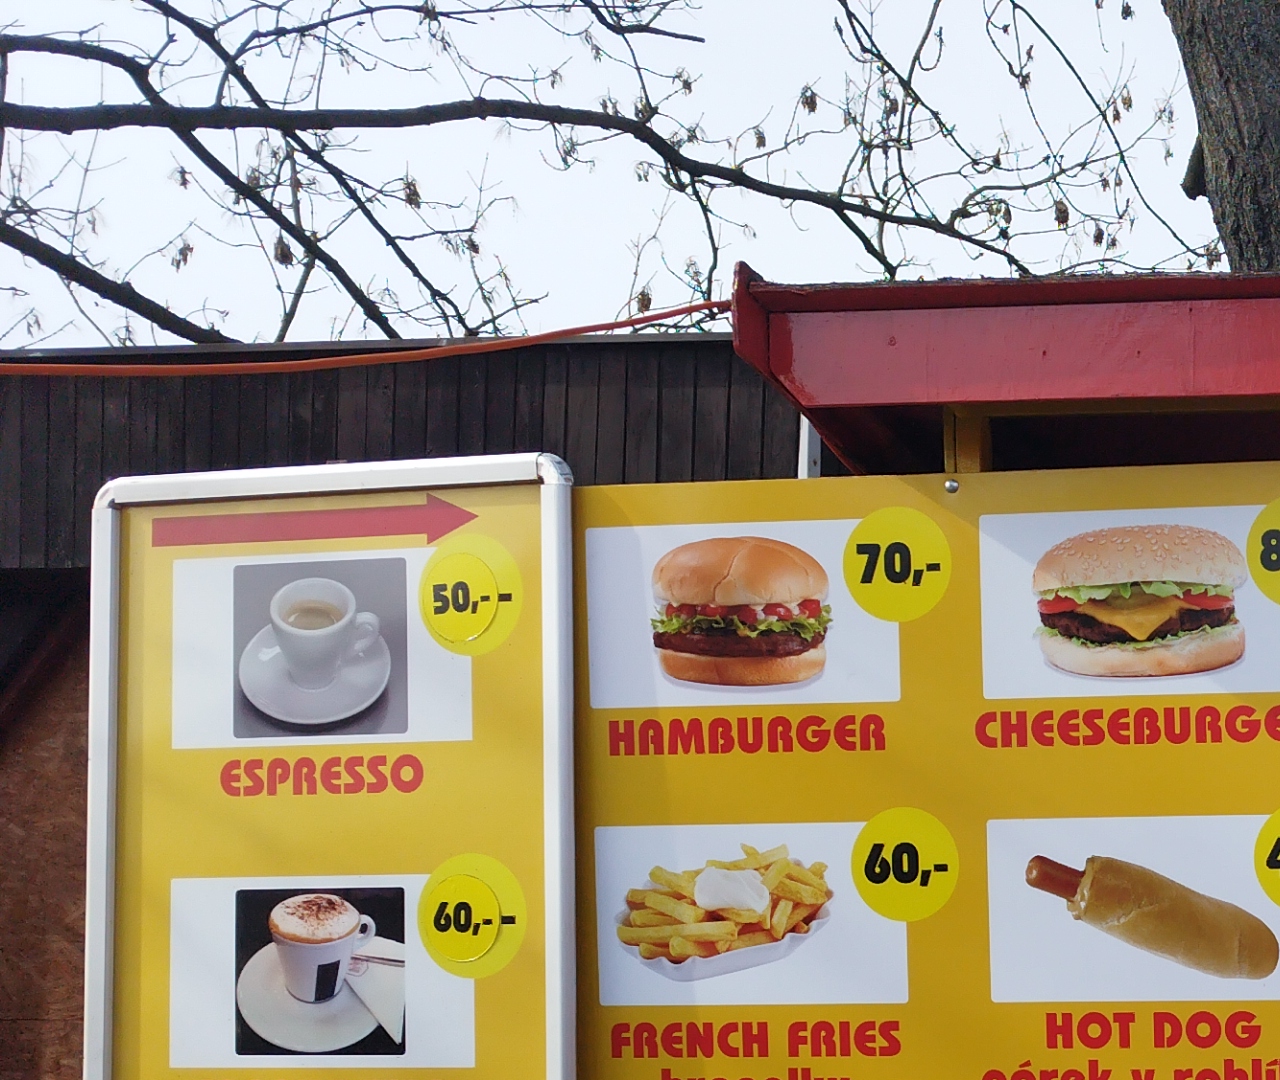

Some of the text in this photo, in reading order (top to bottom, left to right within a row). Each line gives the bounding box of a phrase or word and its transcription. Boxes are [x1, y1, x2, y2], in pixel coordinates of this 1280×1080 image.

[856, 543, 941, 587] 70,-
[608, 714, 887, 756] HAMBURGER
[220, 755, 424, 797] ESPRESSO
[864, 841, 949, 887] 60,-
[611, 1020, 902, 1059] FRENCH FRIES
[1045, 1011, 1262, 1050] HOT DOG
